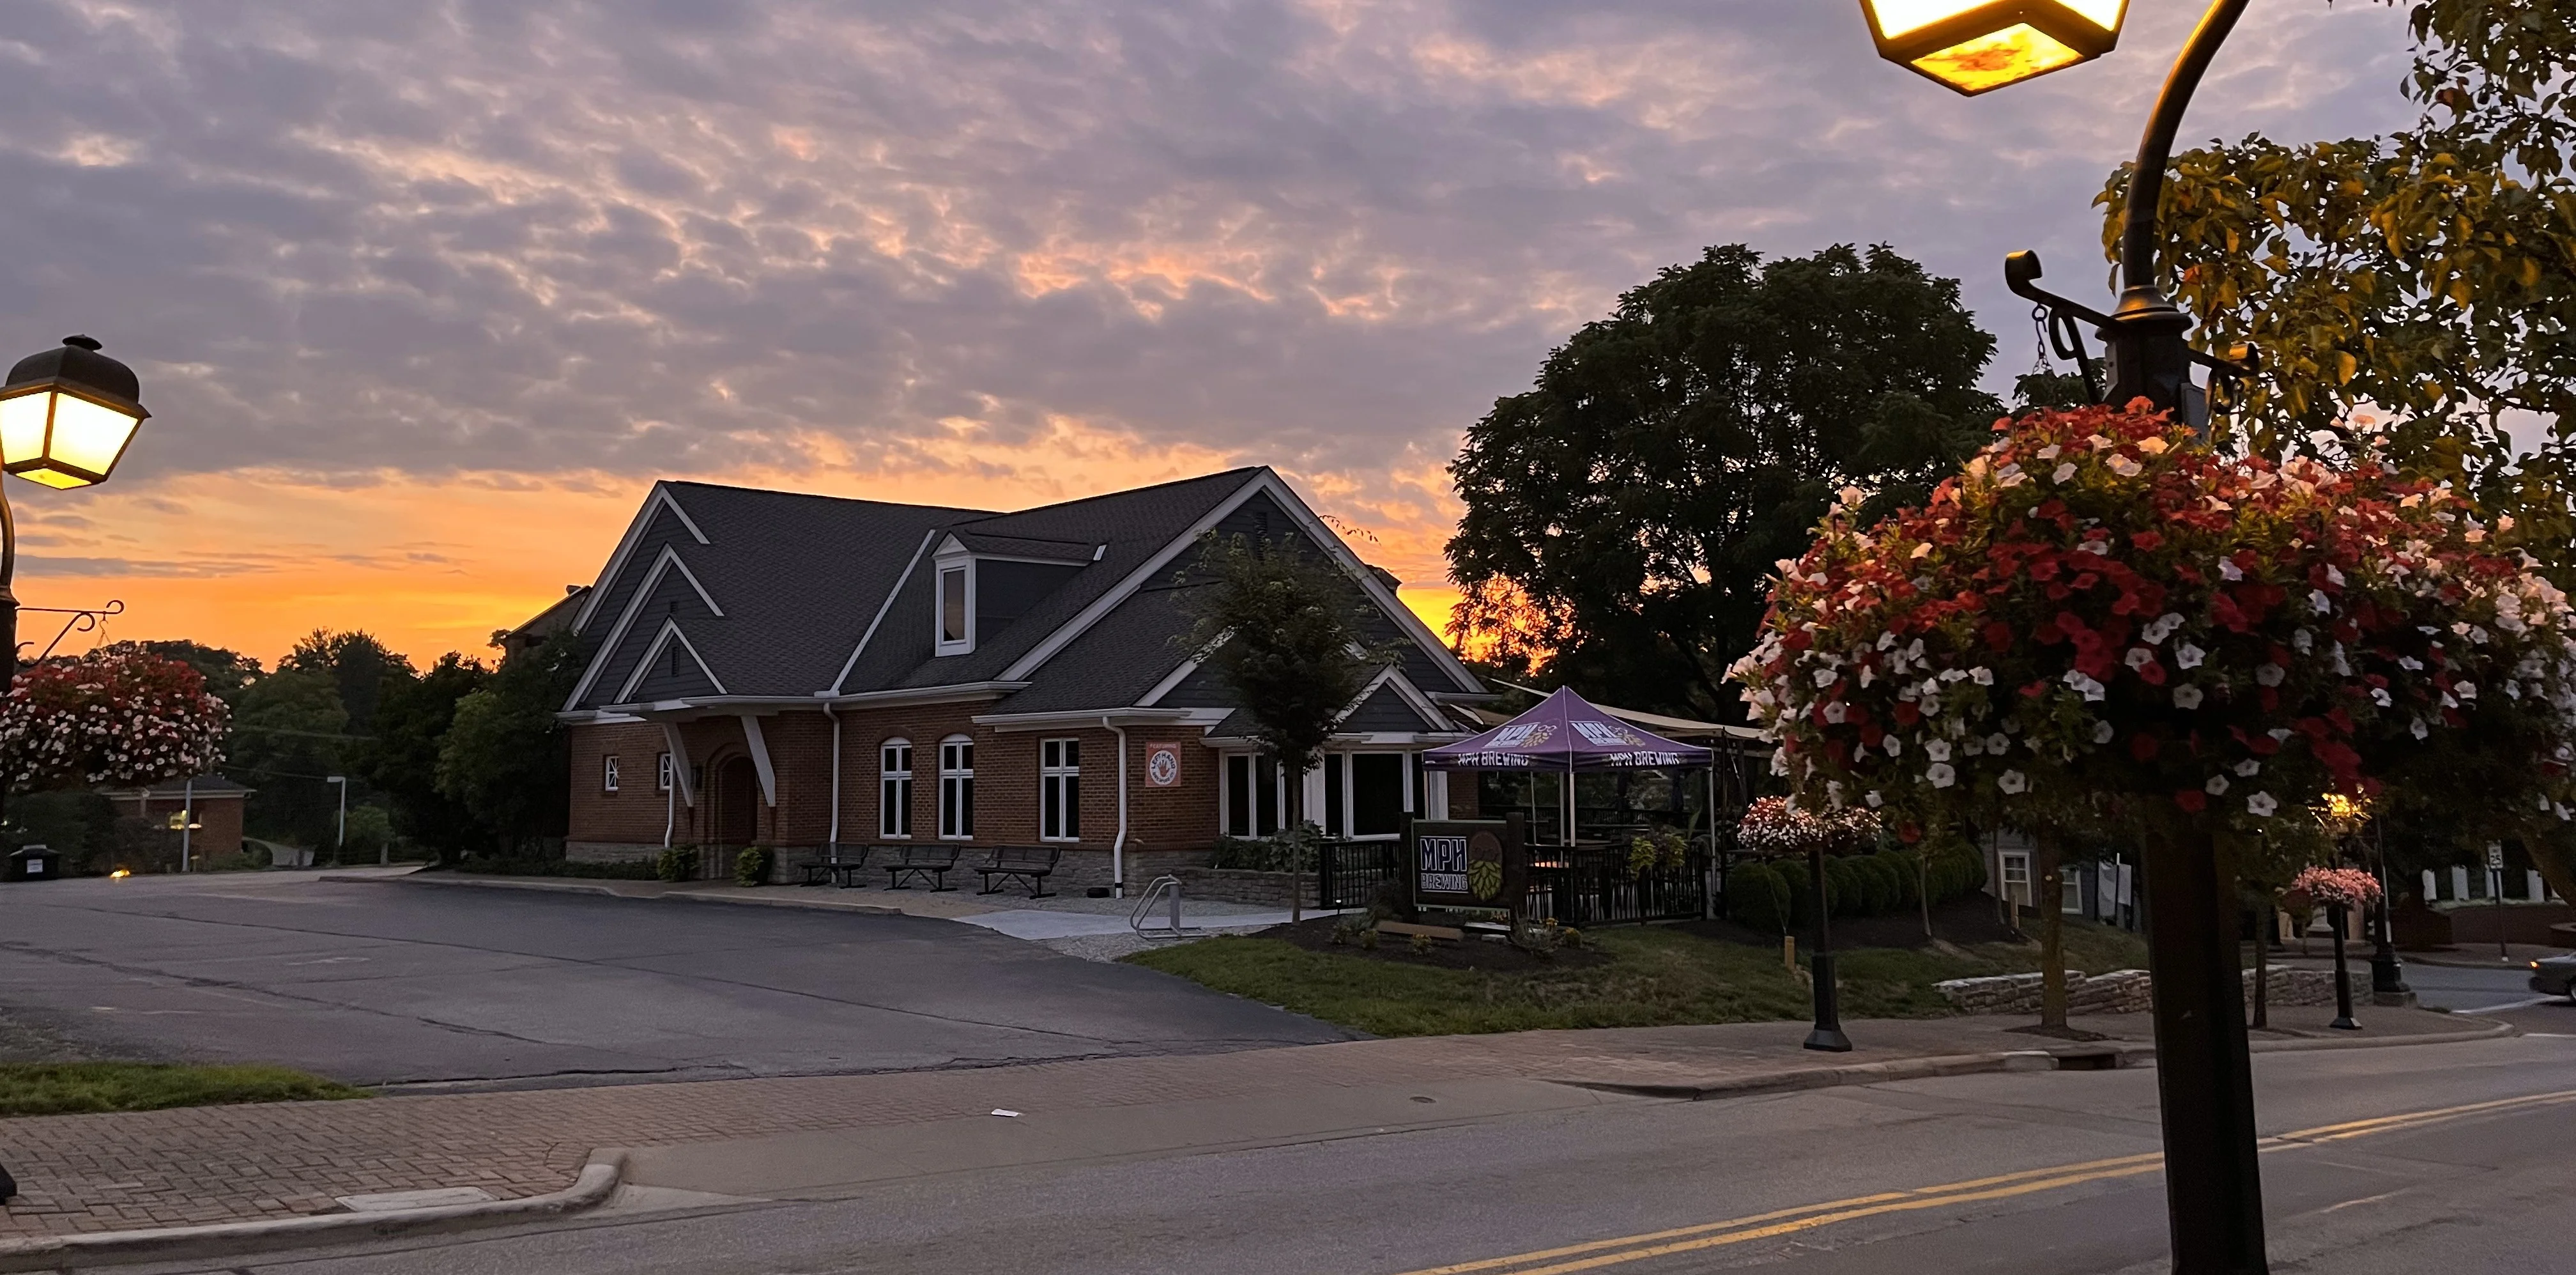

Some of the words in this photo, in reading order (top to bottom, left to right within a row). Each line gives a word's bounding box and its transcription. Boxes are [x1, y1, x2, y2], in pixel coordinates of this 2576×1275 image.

[1492, 723, 1538, 741] MPH
[1571, 723, 1616, 738] MPH
[1151, 753, 1161, 769] LEFT
[1162, 752, 1176, 769] HAND
[1457, 752, 1479, 766] MPH
[1481, 751, 1529, 766] BREWING
[1609, 752, 1632, 766] MPH
[1633, 751, 1680, 766] BREWING
[1420, 838, 1468, 872] MPH
[2490, 854, 2501, 865] 25
[1420, 872, 1468, 890] BREWING
